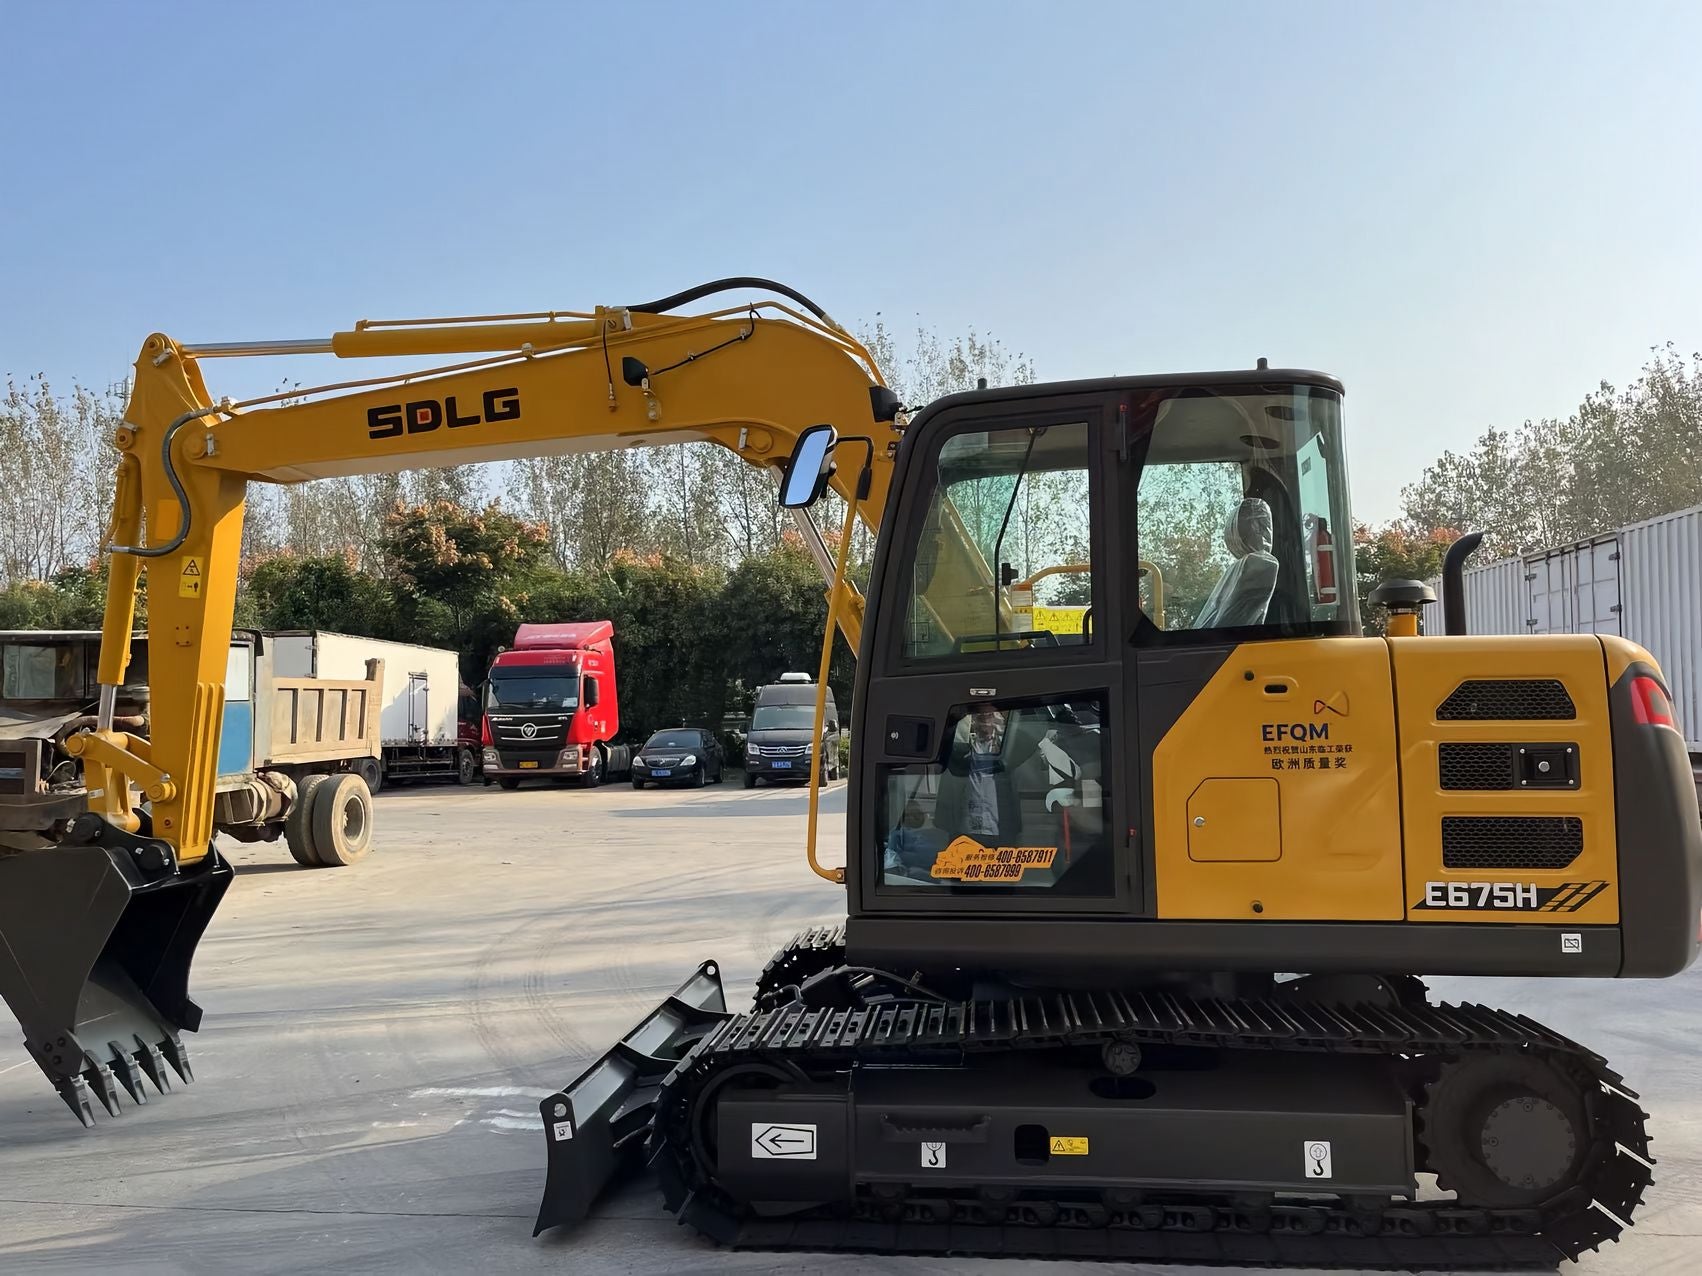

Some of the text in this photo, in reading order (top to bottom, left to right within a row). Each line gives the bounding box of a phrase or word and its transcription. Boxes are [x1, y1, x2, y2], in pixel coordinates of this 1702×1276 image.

[367, 387, 521, 439] SDLG
[1262, 723, 1329, 742] EFQM
[1271, 757, 1347, 770] 欧洲质量奖
[1425, 881, 1538, 908] E675H
